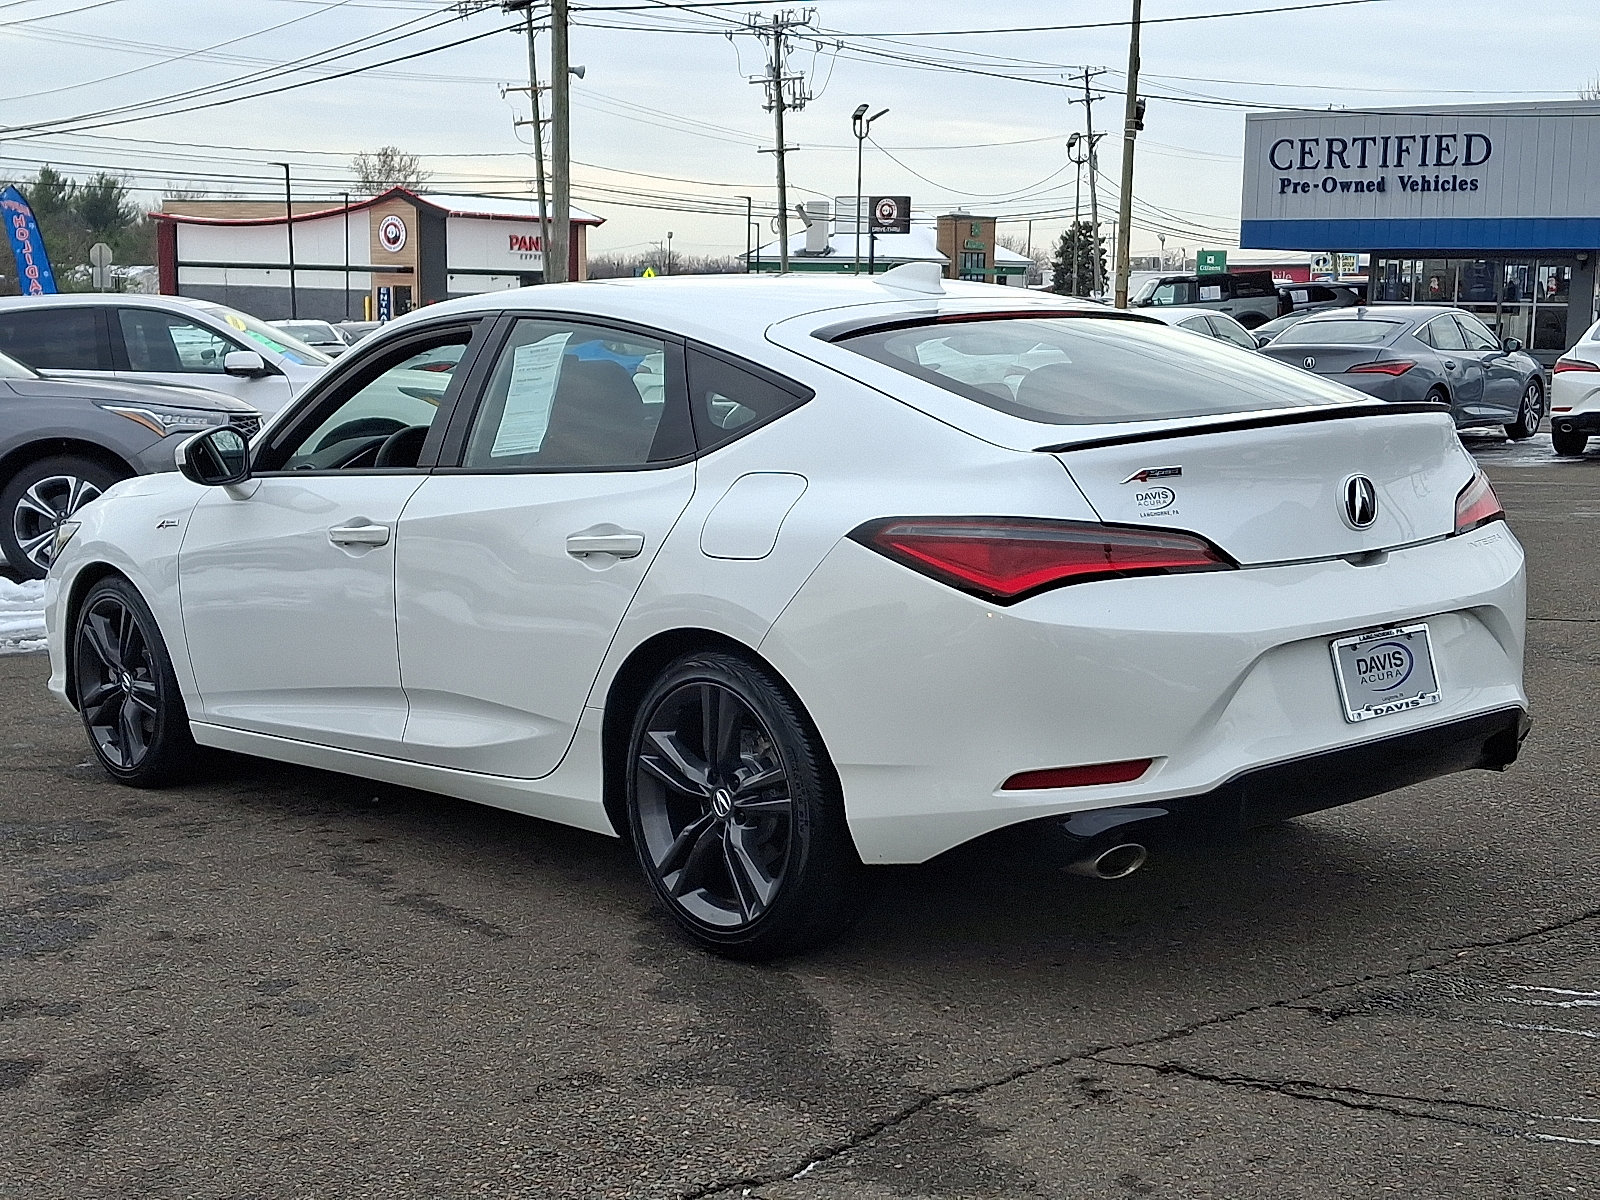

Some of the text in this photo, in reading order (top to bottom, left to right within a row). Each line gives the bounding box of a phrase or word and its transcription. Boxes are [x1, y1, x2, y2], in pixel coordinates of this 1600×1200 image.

[1268, 133, 1493, 171] CERTIFIED
[1278, 174, 1479, 194] Pre-Owned Vehicles
[508, 234, 543, 252] PAN
[1271, 270, 1293, 280] bile
[379, 287, 389, 321] ENTRA
[1135, 490, 1169, 502] DAVIS
[1356, 650, 1404, 676] DAVIS
[1360, 668, 1403, 685] ACURA
[1374, 699, 1421, 716] DAVIS
